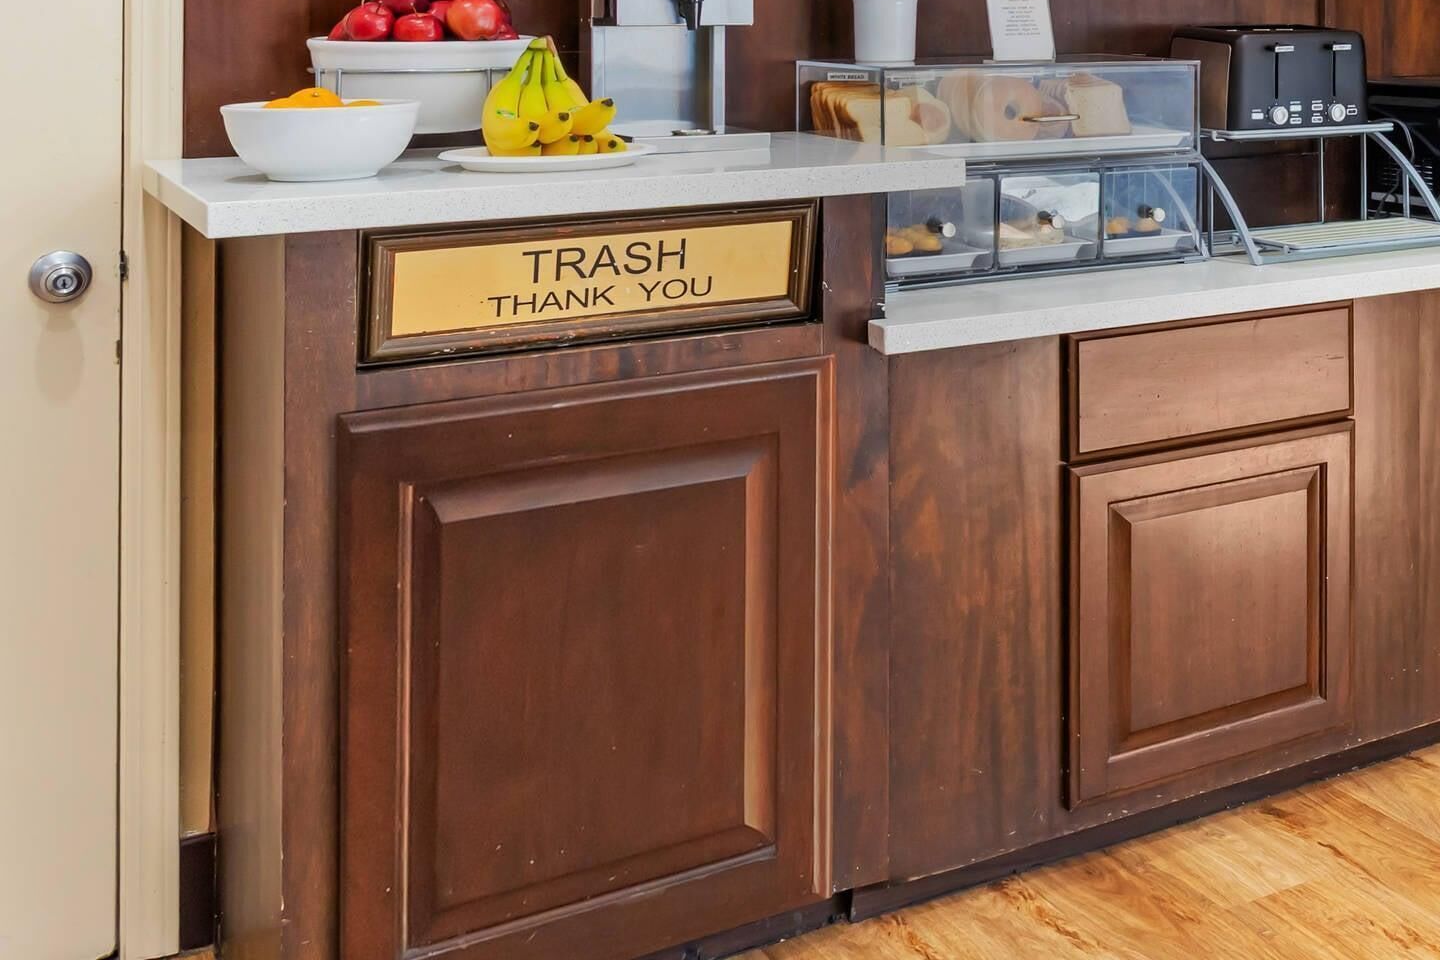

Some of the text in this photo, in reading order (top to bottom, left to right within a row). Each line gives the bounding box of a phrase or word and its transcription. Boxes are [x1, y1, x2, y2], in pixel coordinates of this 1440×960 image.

[522, 238, 687, 284] TRASH
[487, 275, 713, 318] THANK YOU
